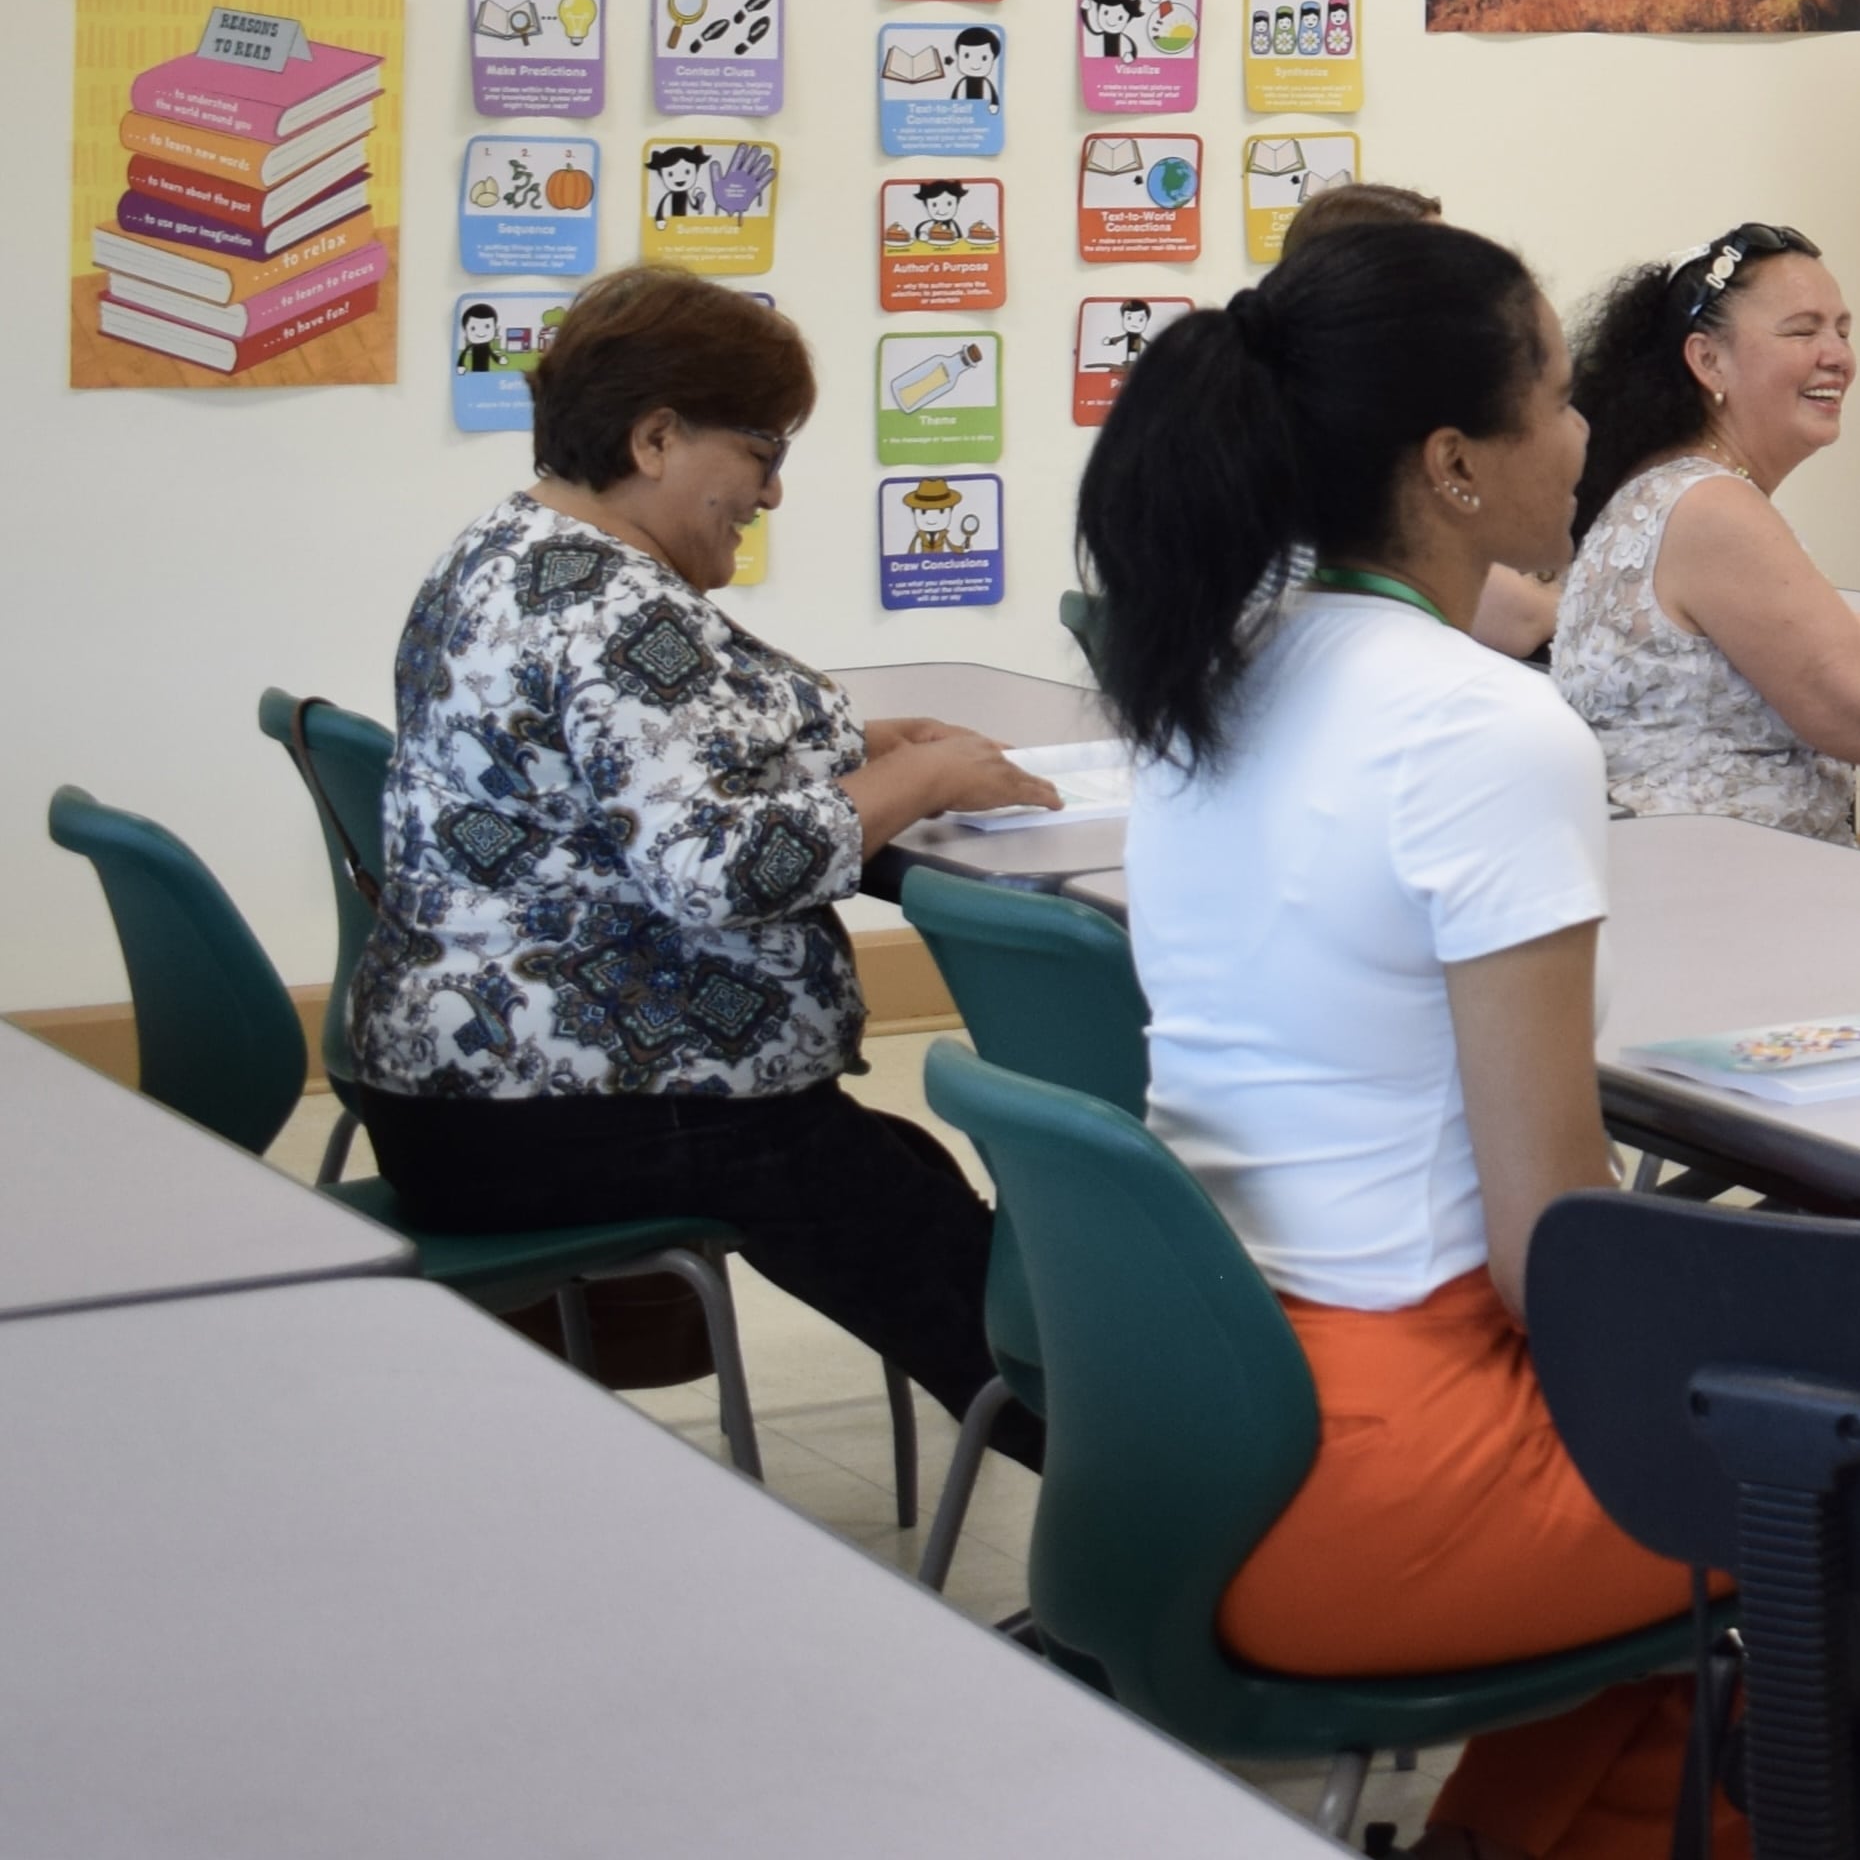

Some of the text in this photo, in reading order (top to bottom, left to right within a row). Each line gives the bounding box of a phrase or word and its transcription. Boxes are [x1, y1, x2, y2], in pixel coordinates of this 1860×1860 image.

[221, 13, 279, 37] REASONS
[215, 38, 272, 60] TO READ
[486, 65, 587, 77] Make Predictions
[676, 66, 756, 77] Context Clues
[1114, 64, 1160, 75] Visualize
[187, 94, 238, 112] understand
[156, 99, 252, 131] the world around you
[166, 137, 192, 153] learn
[194, 148, 217, 160] new
[219, 156, 250, 171] words
[160, 178, 183, 193] learn
[185, 187, 211, 201] about
[214, 193, 229, 206] the
[231, 201, 251, 212] past
[1101, 211, 1176, 221] Text-to-World
[157, 219, 173, 228] use
[175, 223, 198, 234] your
[200, 225, 253, 247] imagination
[1105, 222, 1172, 233] Connections
[304, 233, 347, 259] relax
[893, 261, 989, 274] Author's Purpose
[296, 284, 324, 301] learn
[327, 277, 339, 288] to
[342, 263, 375, 282] focus
[297, 316, 325, 333] have
[327, 301, 350, 320] fun!
[919, 415, 957, 426] Theme
[891, 558, 989, 572] Draw Conclusions
